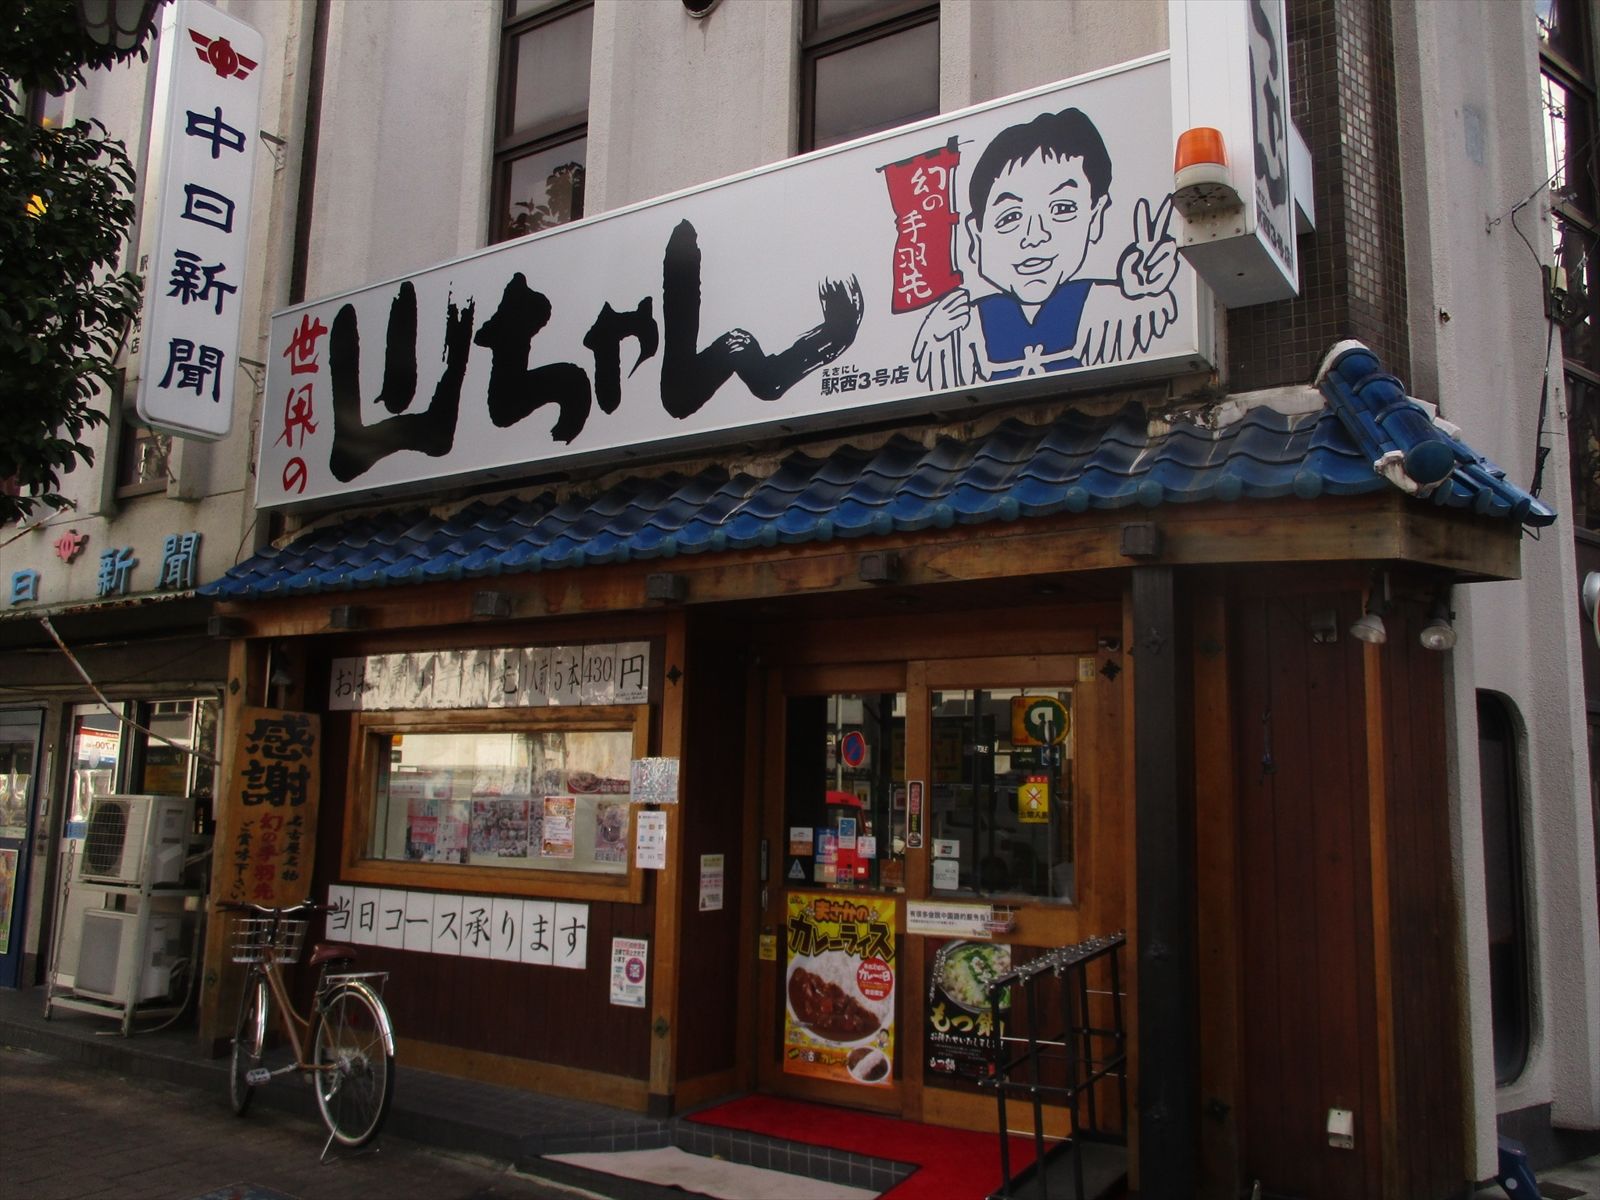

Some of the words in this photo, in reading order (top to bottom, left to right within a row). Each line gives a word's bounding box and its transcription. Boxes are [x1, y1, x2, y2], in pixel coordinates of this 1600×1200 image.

[157, 106, 247, 404] 中日新聞
[897, 166, 947, 305] 幻の手羽先
[329, 218, 865, 484] 山ちゃん
[820, 365, 910, 396] 駅西3号店
[822, 364, 860, 377] えきにし
[273, 313, 328, 494] 世界の
[241, 713, 315, 808] 感謝
[253, 812, 285, 900] 幻の手羽先
[327, 895, 586, 957] 当日コース承ります
[788, 913, 896, 961] カレーライス
[814, 897, 871, 922] まさかの
